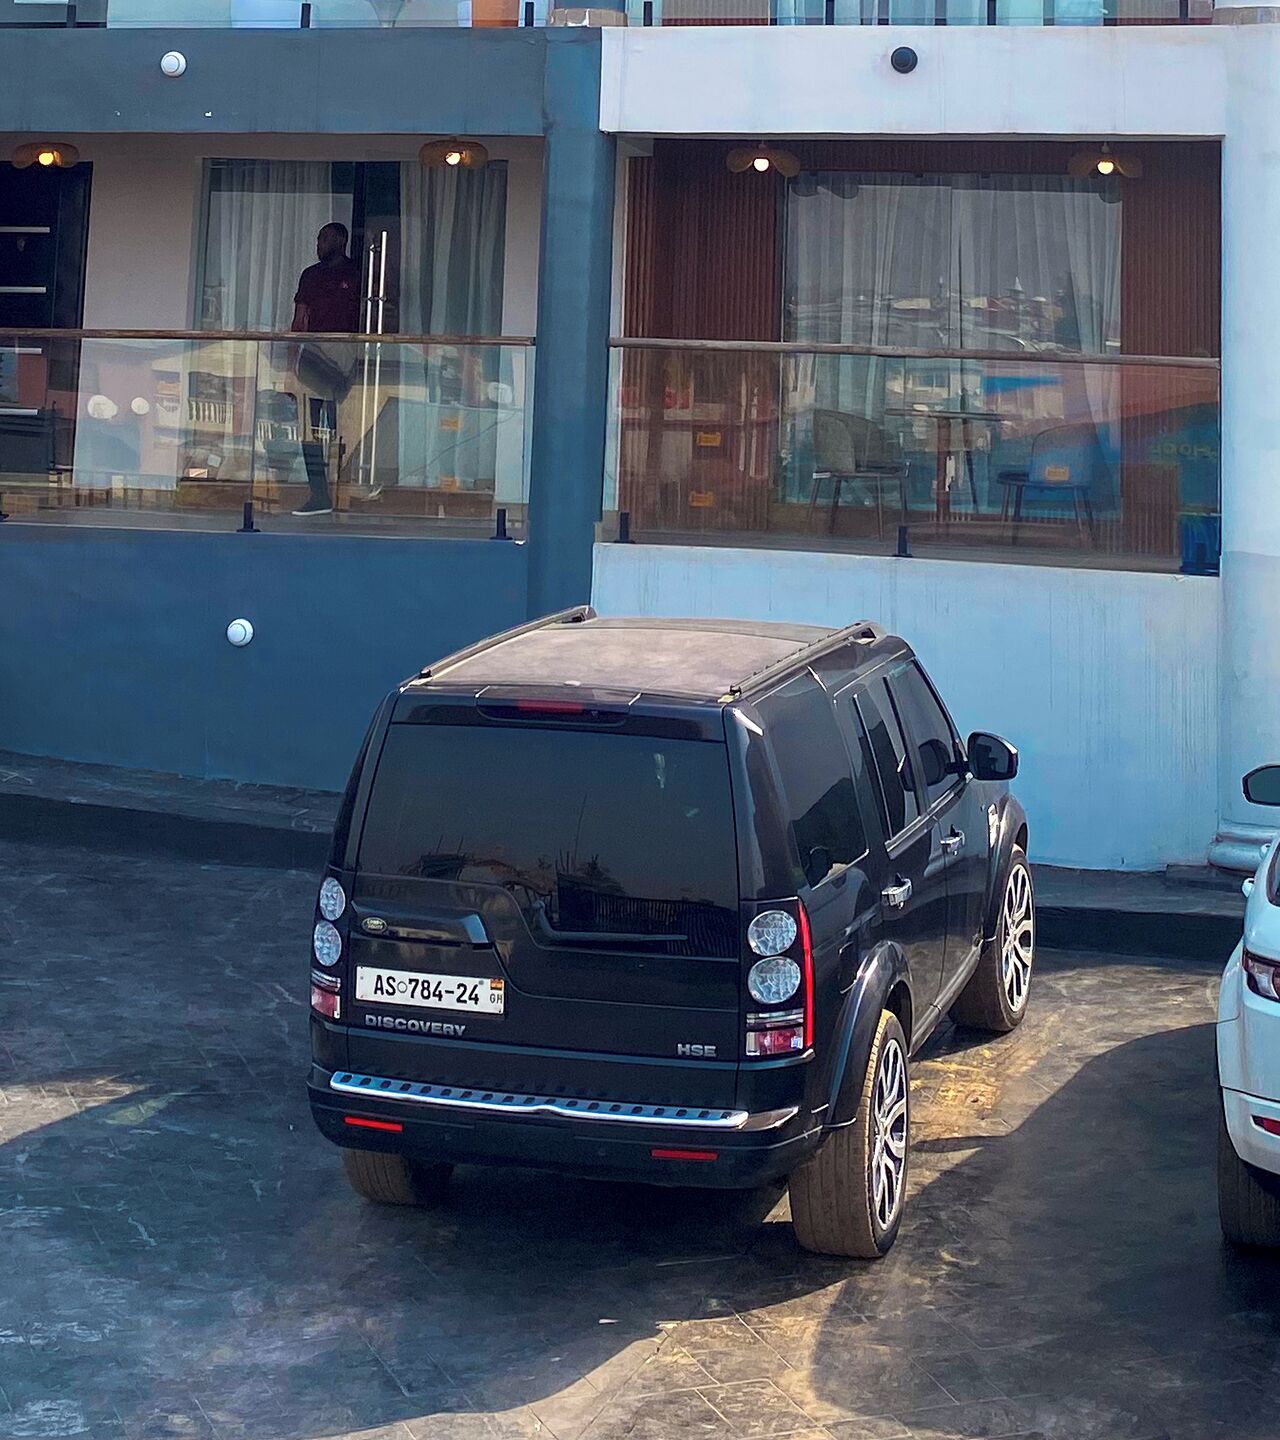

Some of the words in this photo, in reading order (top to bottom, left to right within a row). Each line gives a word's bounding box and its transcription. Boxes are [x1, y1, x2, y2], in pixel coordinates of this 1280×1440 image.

[489, 993, 503, 1004] GH
[365, 1014, 466, 1037] DISCOVERY
[677, 1043, 717, 1058] HSE
